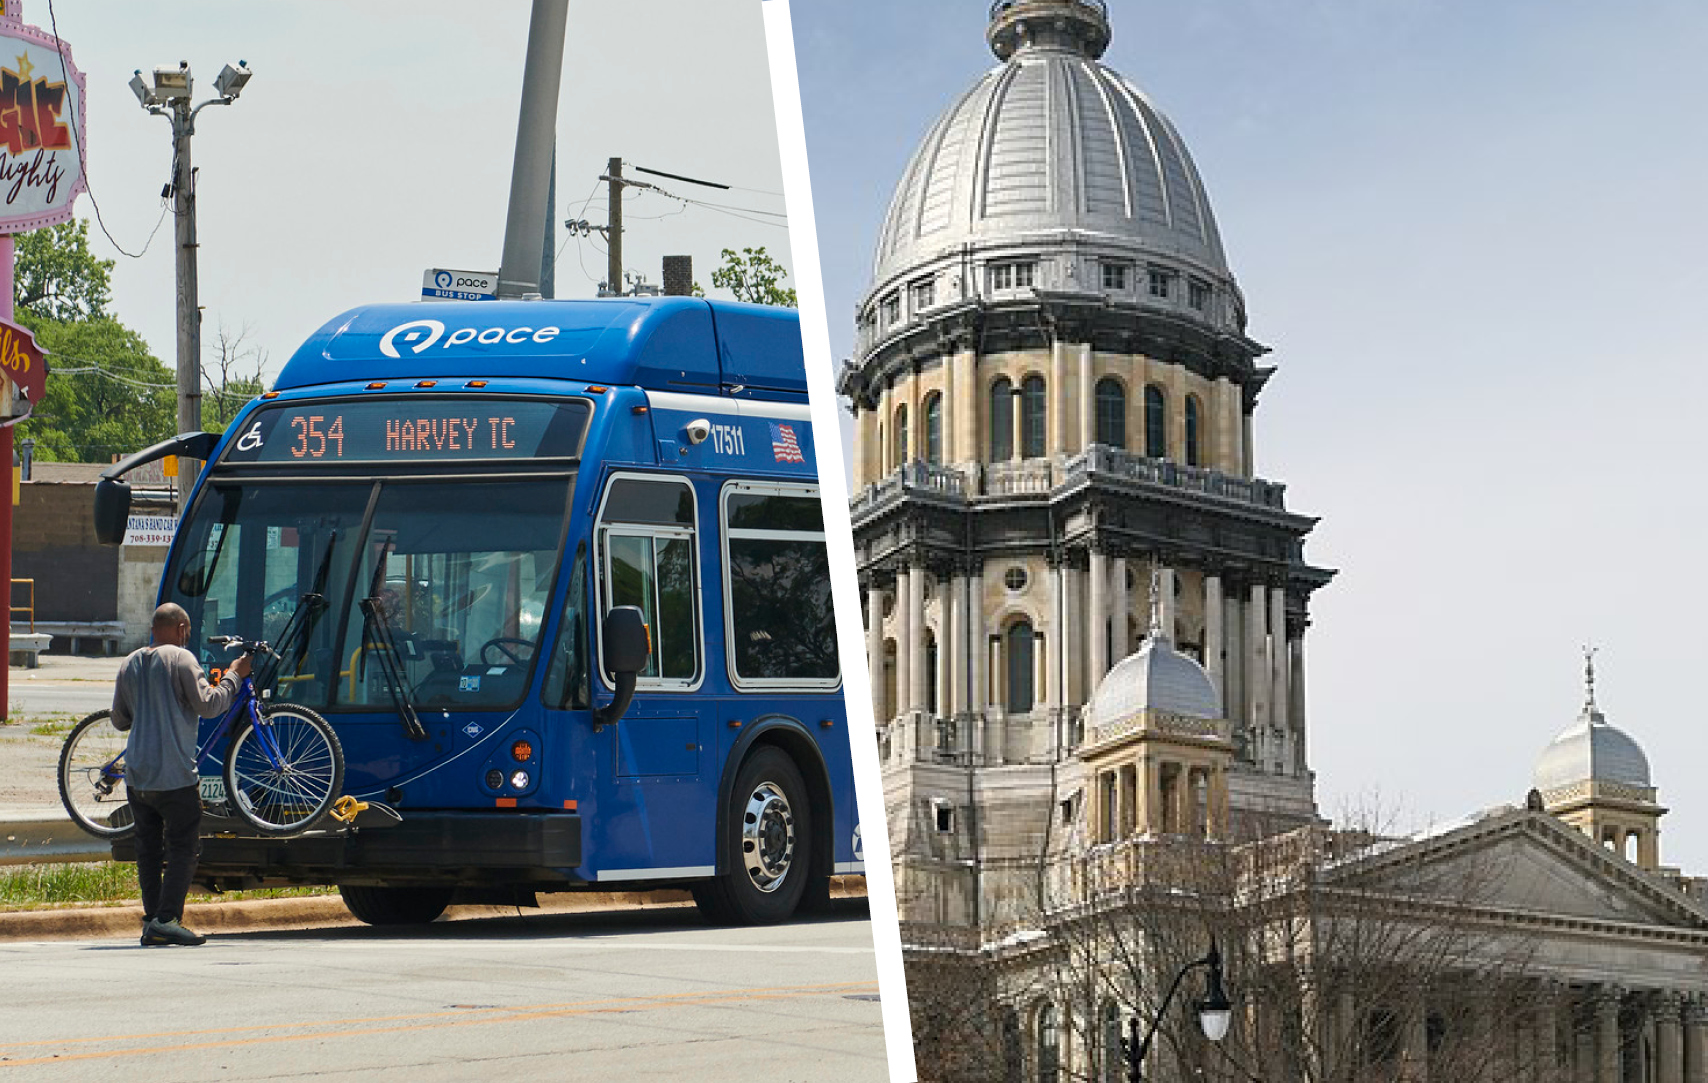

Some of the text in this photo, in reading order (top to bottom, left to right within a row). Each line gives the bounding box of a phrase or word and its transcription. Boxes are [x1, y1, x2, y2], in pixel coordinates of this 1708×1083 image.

[456, 277, 488, 288] pace
[435, 289, 482, 300] BUS STOP
[443, 326, 561, 349] pace
[291, 416, 516, 457] 354 HARVEY TC
[710, 424, 745, 456] 17511
